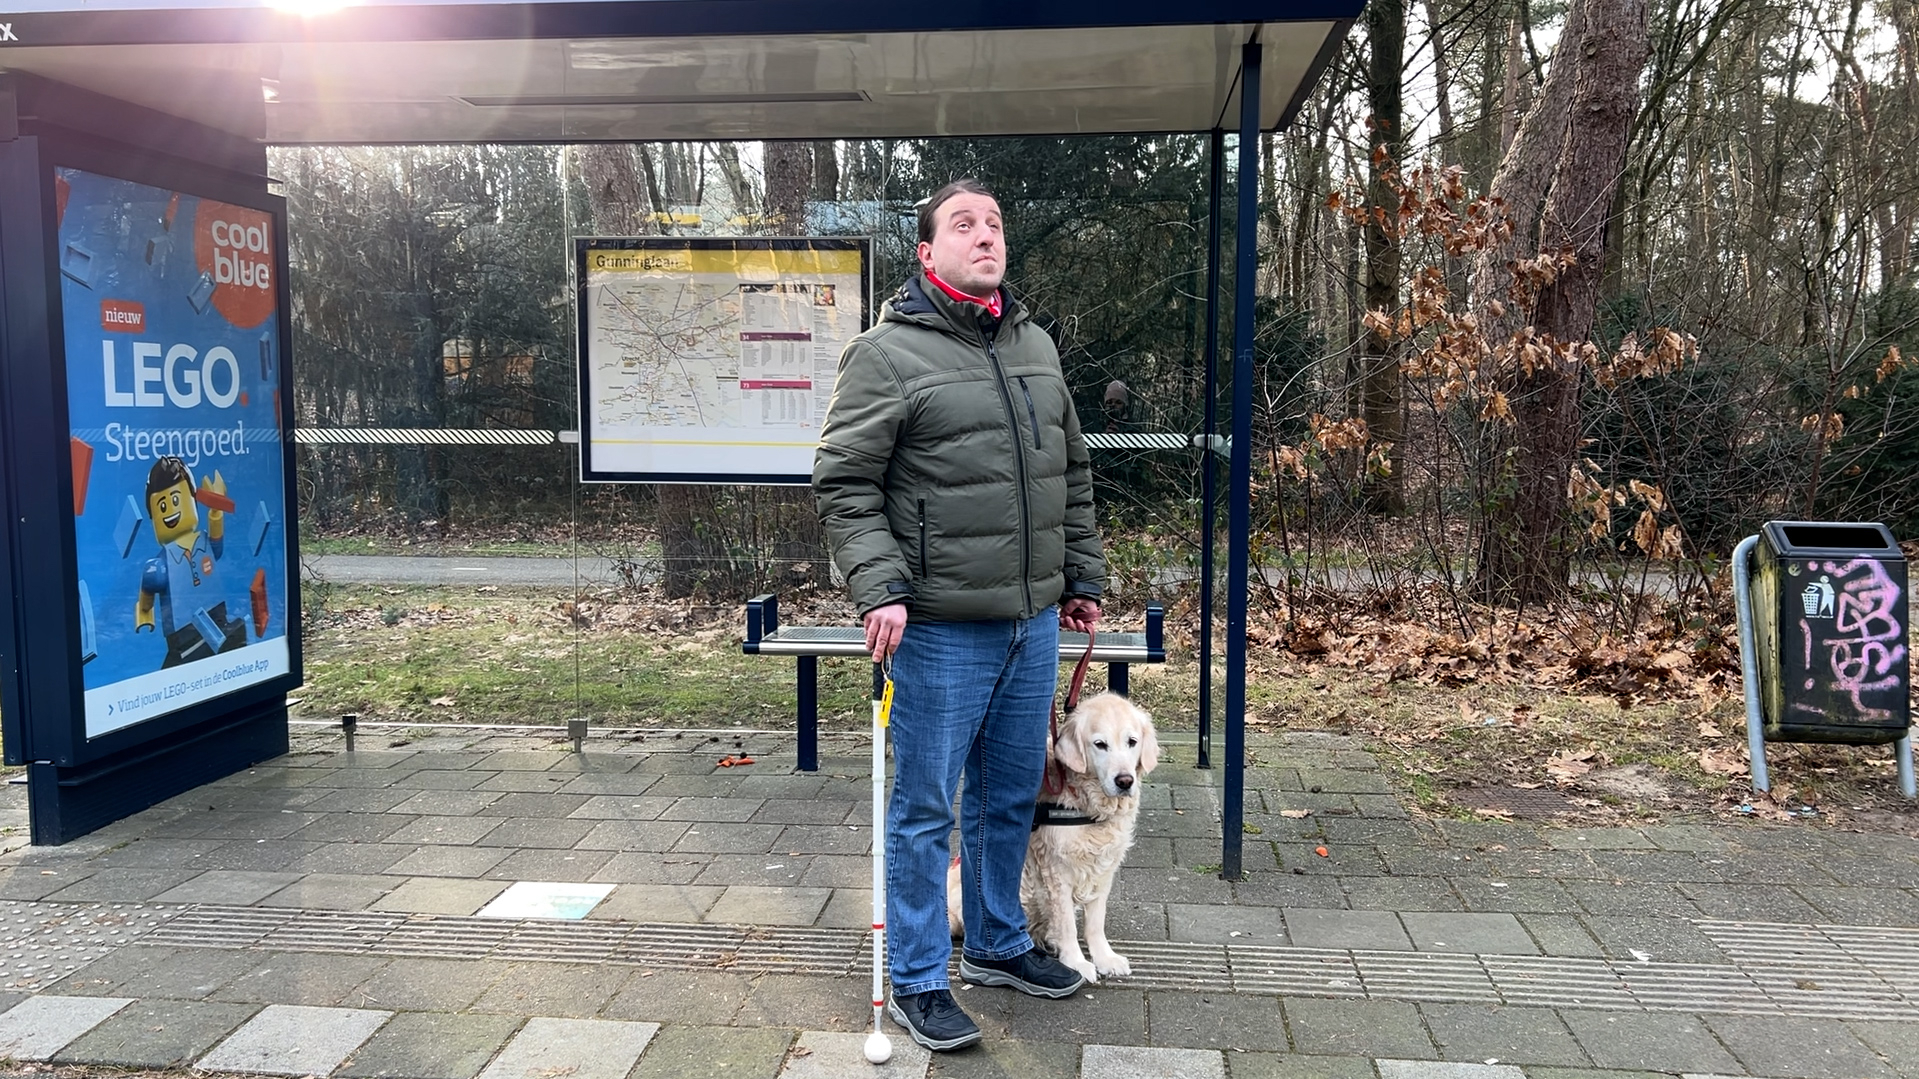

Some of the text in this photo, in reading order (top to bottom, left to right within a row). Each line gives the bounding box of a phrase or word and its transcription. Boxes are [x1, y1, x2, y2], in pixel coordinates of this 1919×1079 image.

[0, 22, 19, 41] X
[211, 220, 269, 255] cool
[213, 247, 270, 290] blue
[105, 307, 142, 325] nieuw
[104, 420, 250, 468] Steengoed.
[117, 695, 140, 713] Vind
[140, 691, 163, 709] jouw
[204, 676, 213, 688] in
[212, 672, 222, 685] de
[222, 663, 254, 681] Coolblue
[254, 659, 269, 672] App
